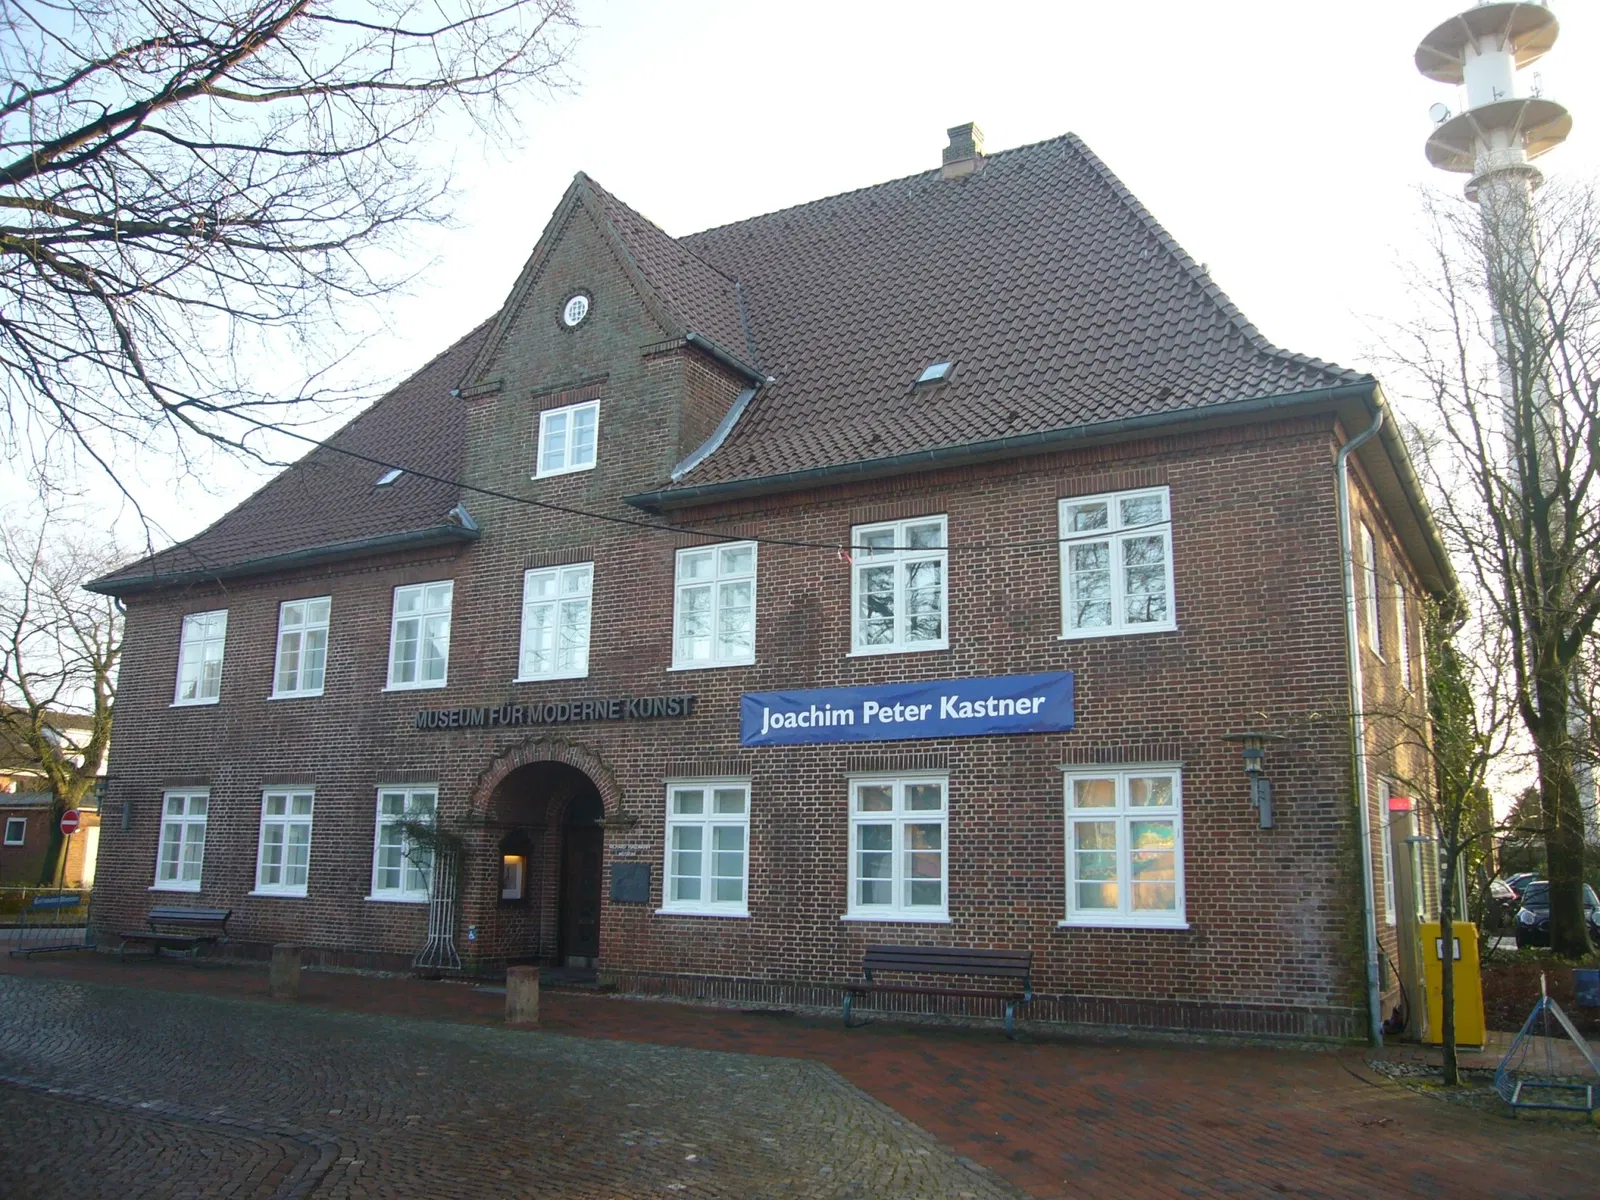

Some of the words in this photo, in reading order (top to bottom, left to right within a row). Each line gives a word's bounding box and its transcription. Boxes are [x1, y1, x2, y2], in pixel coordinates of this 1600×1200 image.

[415, 707, 484, 729] MUSEUM
[489, 702, 524, 725] FÜR
[527, 699, 620, 724] MODERNE
[624, 694, 692, 717] KUNST
[761, 703, 854, 735] Joachim
[863, 701, 932, 724] Peter
[940, 695, 1046, 720] Kastner
